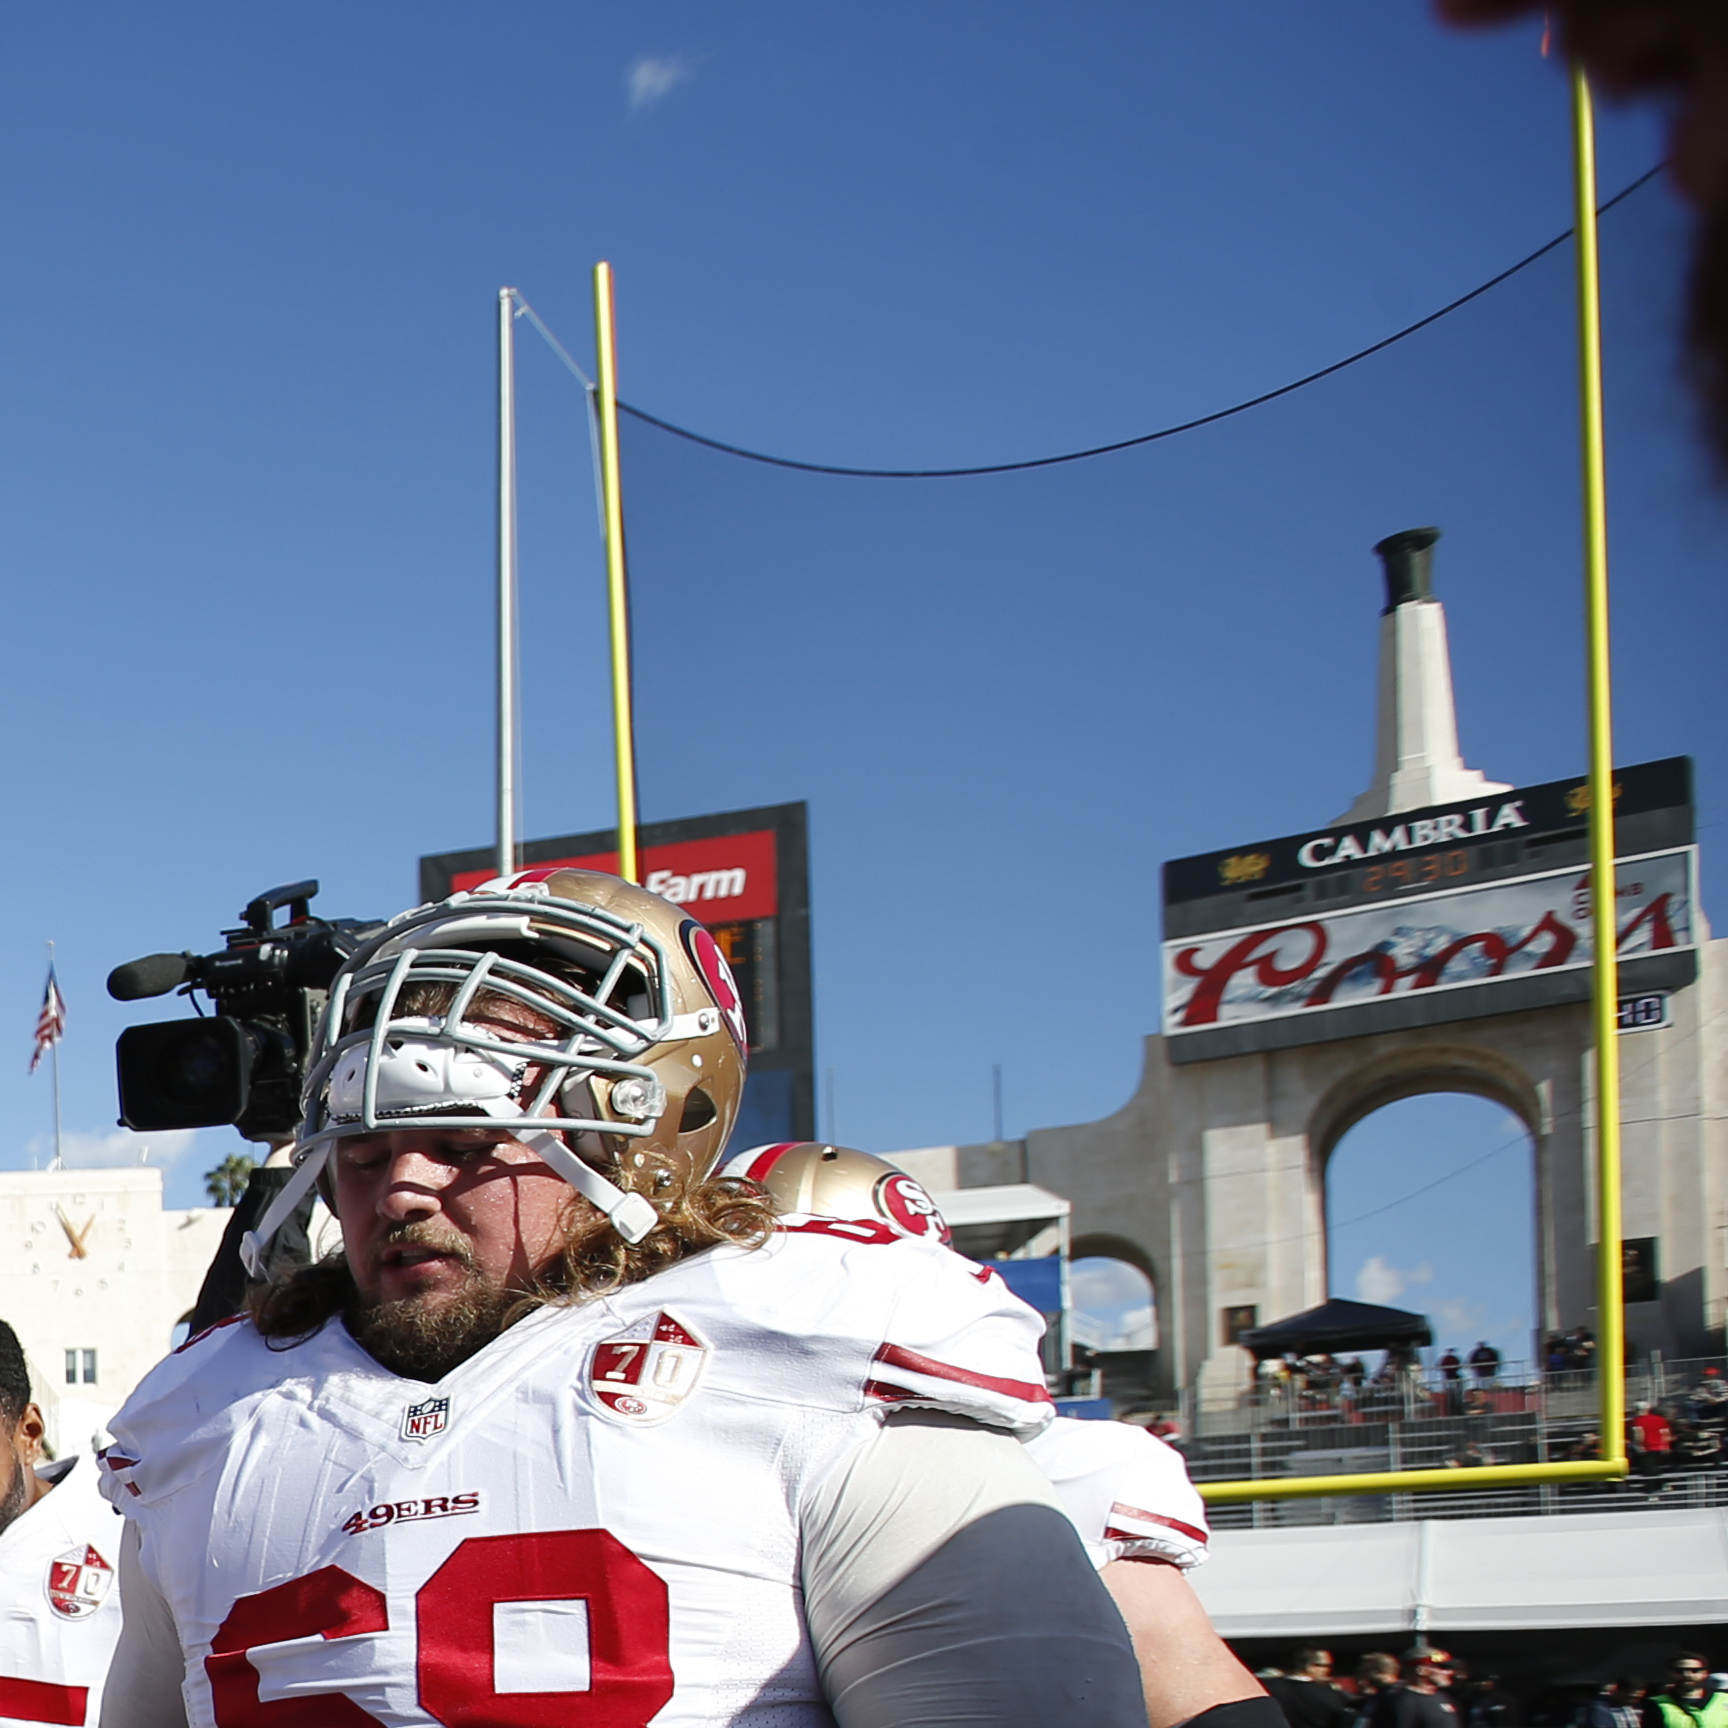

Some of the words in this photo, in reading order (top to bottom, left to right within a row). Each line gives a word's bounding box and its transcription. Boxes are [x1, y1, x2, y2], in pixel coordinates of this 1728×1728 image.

[1297, 800, 1530, 868] CAMBRIA
[646, 867, 746, 904] Farm
[606, 1346, 683, 1388] 70
[409, 1413, 444, 1435] NFL
[341, 1492, 479, 1536] 49ERS
[58, 1565, 100, 1596] 70
